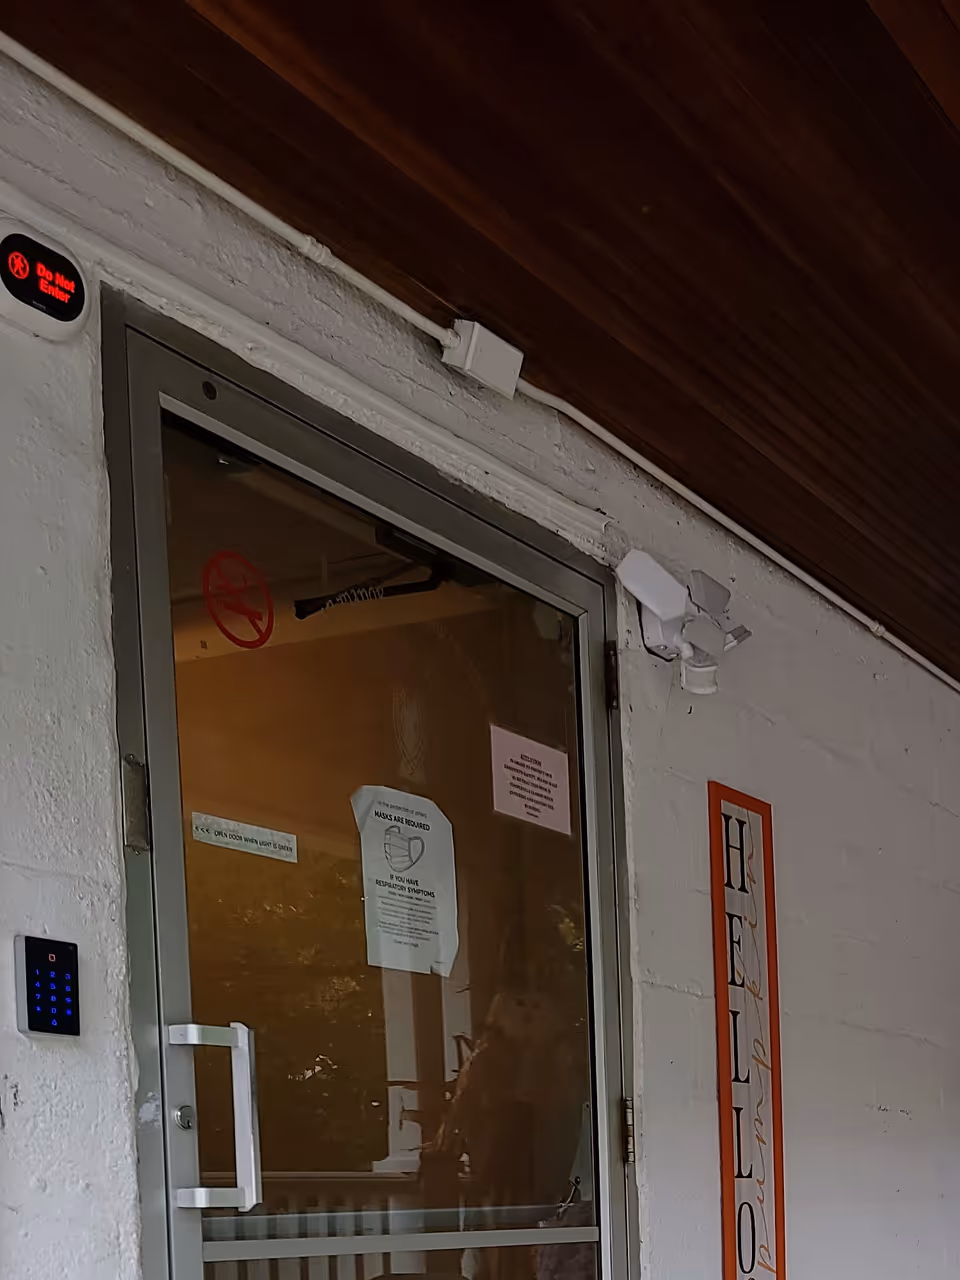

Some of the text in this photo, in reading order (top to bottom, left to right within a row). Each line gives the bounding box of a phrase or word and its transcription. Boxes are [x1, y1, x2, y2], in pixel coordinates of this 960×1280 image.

[36, 262, 75, 293] Do Not
[39, 278, 71, 303] Enter
[374, 810, 431, 832] MASKS ARE REQUIRED
[214, 830, 228, 838] OPEN
[229, 834, 242, 842] DOOR
[243, 837, 258, 845] WHEN
[375, 878, 436, 898] RESPIRATORY SYMPTOMS
[389, 873, 419, 887] IF YOU HAVE
[721, 812, 756, 1274] HELLO
